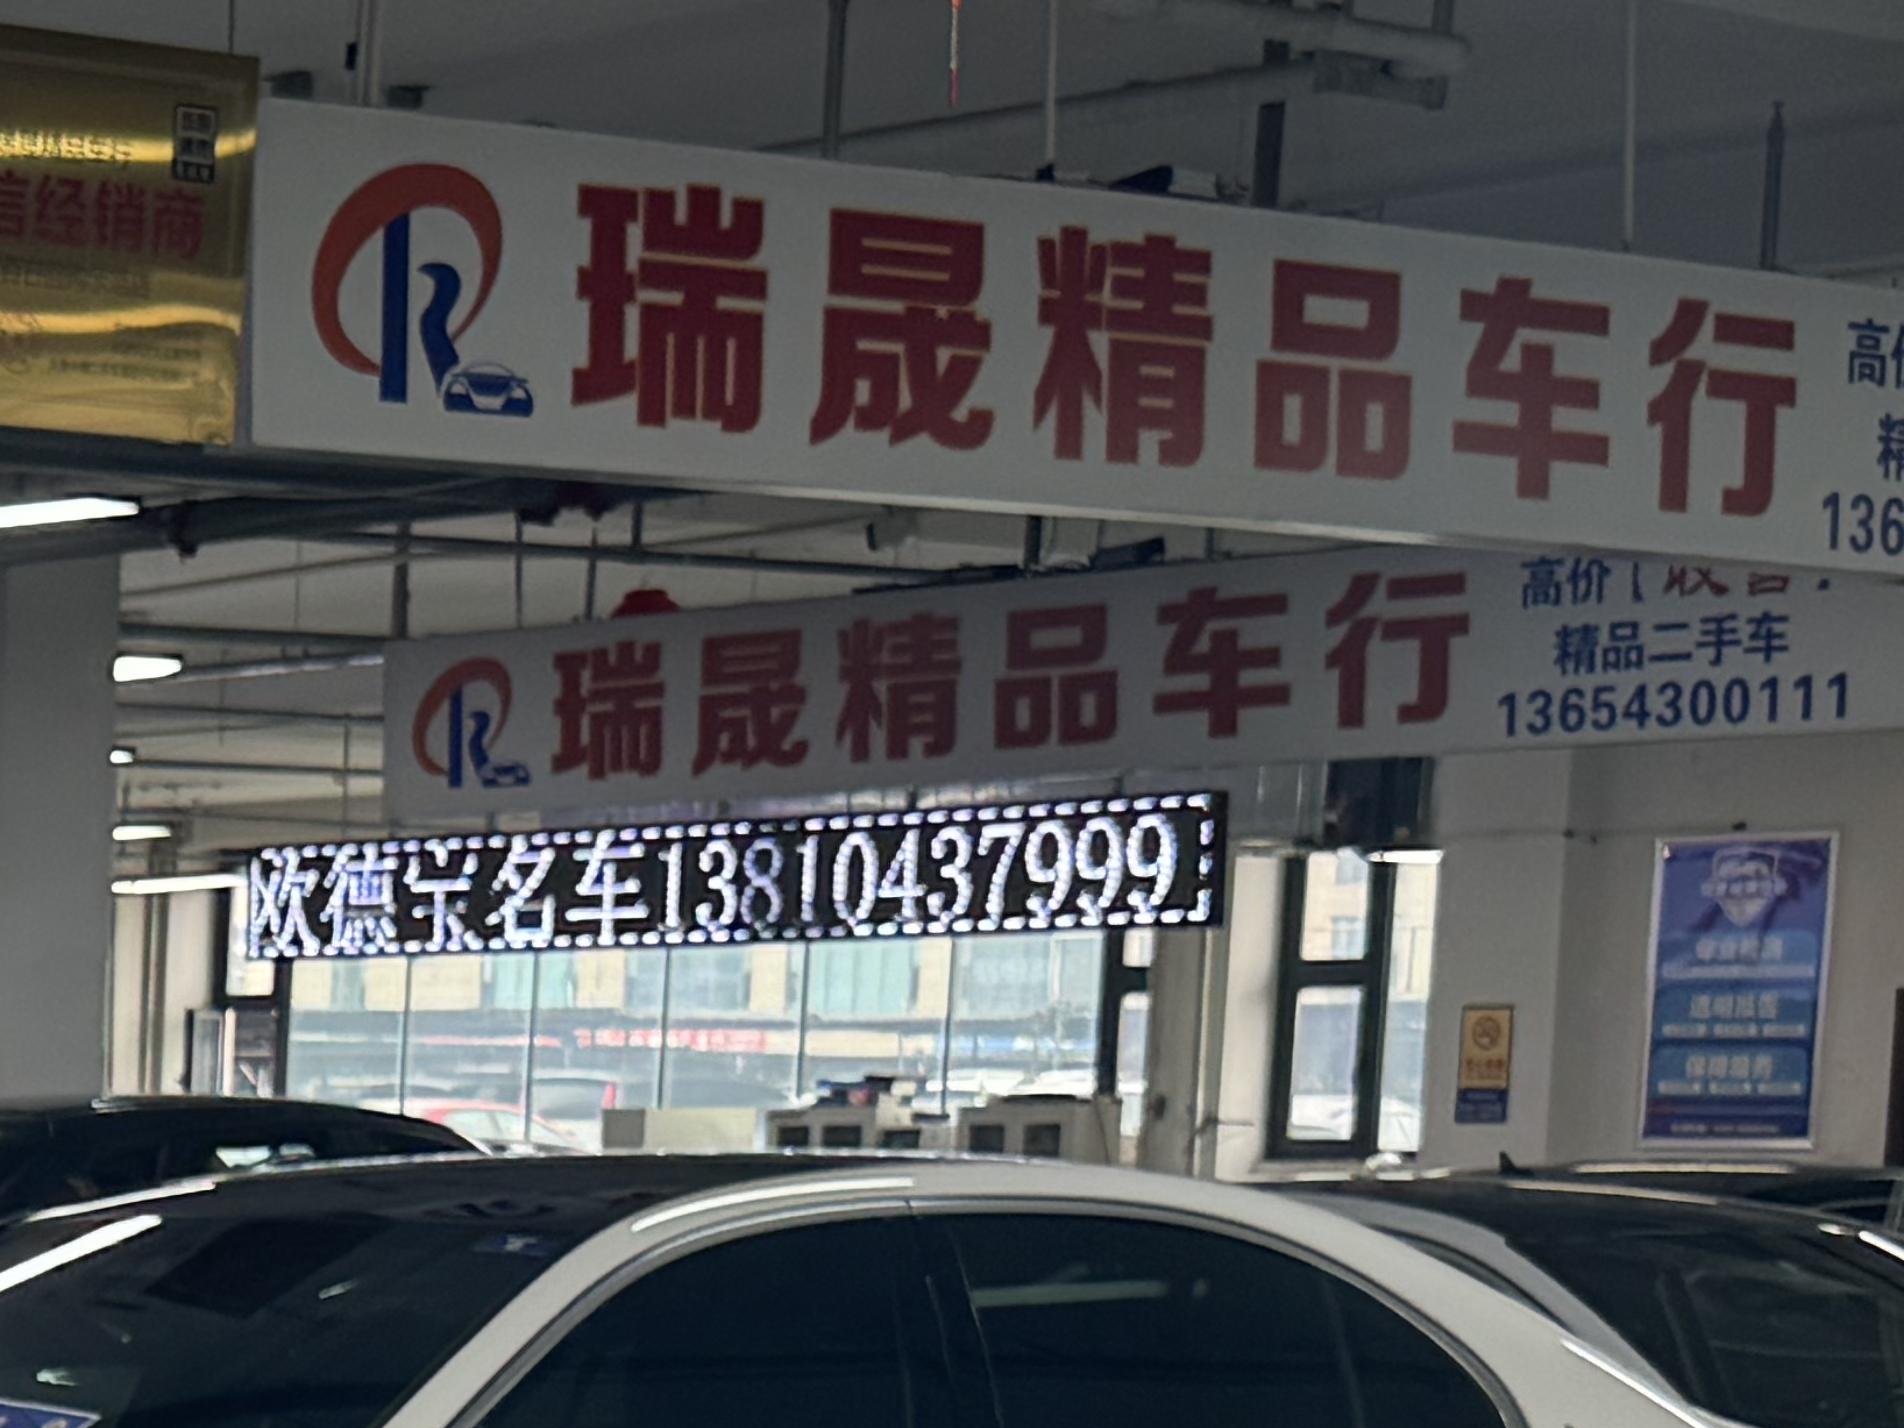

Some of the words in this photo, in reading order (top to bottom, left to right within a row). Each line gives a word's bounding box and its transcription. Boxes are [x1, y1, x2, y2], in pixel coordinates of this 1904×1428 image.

[569, 181, 1797, 518] 瑞晟精品车行
[550, 570, 1471, 780] 瑞晟精品车行
[1498, 672, 1849, 738] 13654300111
[1553, 611, 1790, 677] 精品二手车
